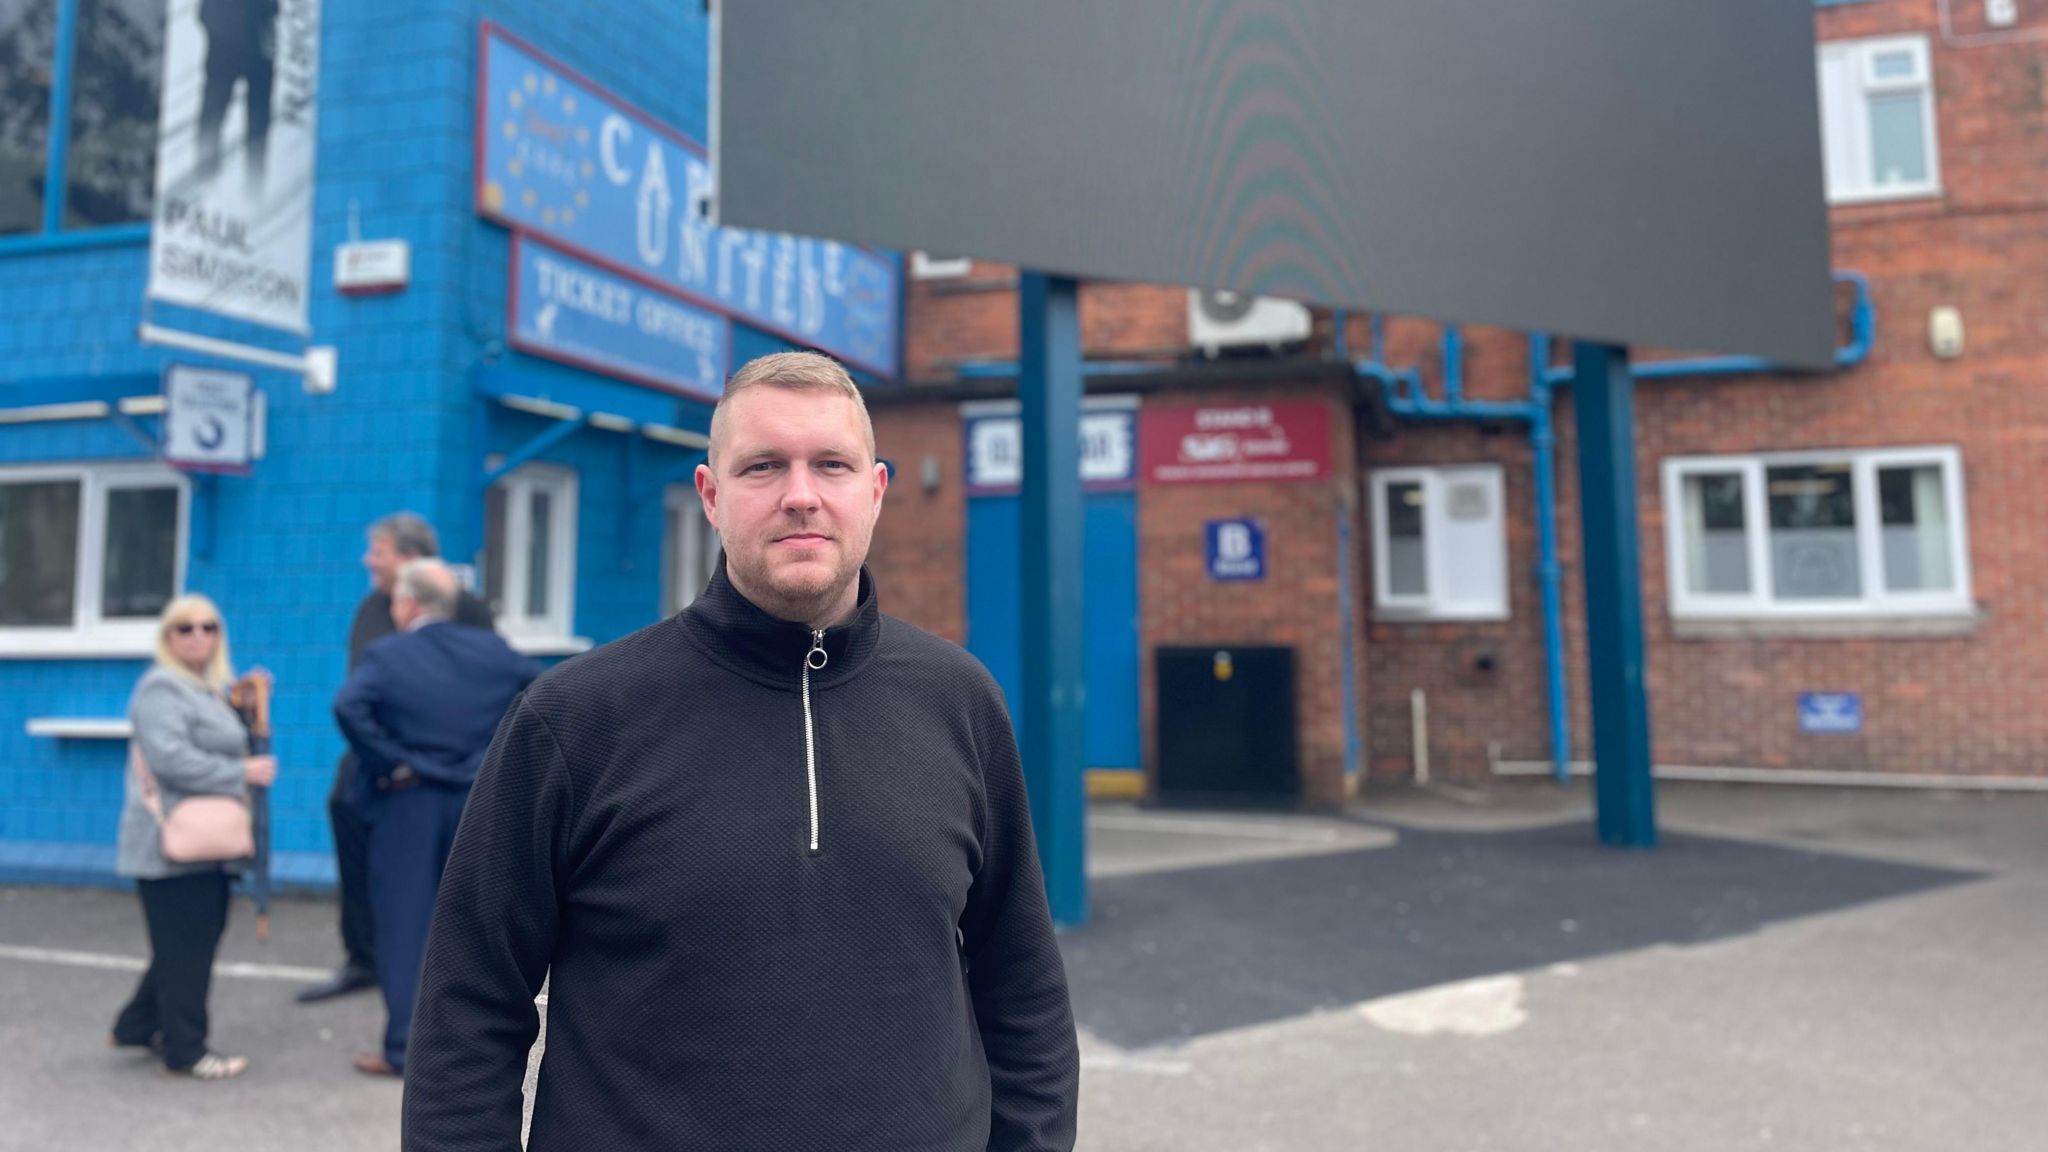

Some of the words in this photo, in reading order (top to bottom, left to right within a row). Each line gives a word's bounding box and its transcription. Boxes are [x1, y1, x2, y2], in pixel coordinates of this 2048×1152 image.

[164, 197, 256, 255] PAUL
[636, 176, 826, 335] UNITED
[533, 256, 632, 326] TICKET
[635, 296, 719, 356] OFFICE
[1217, 522, 1253, 559] B
